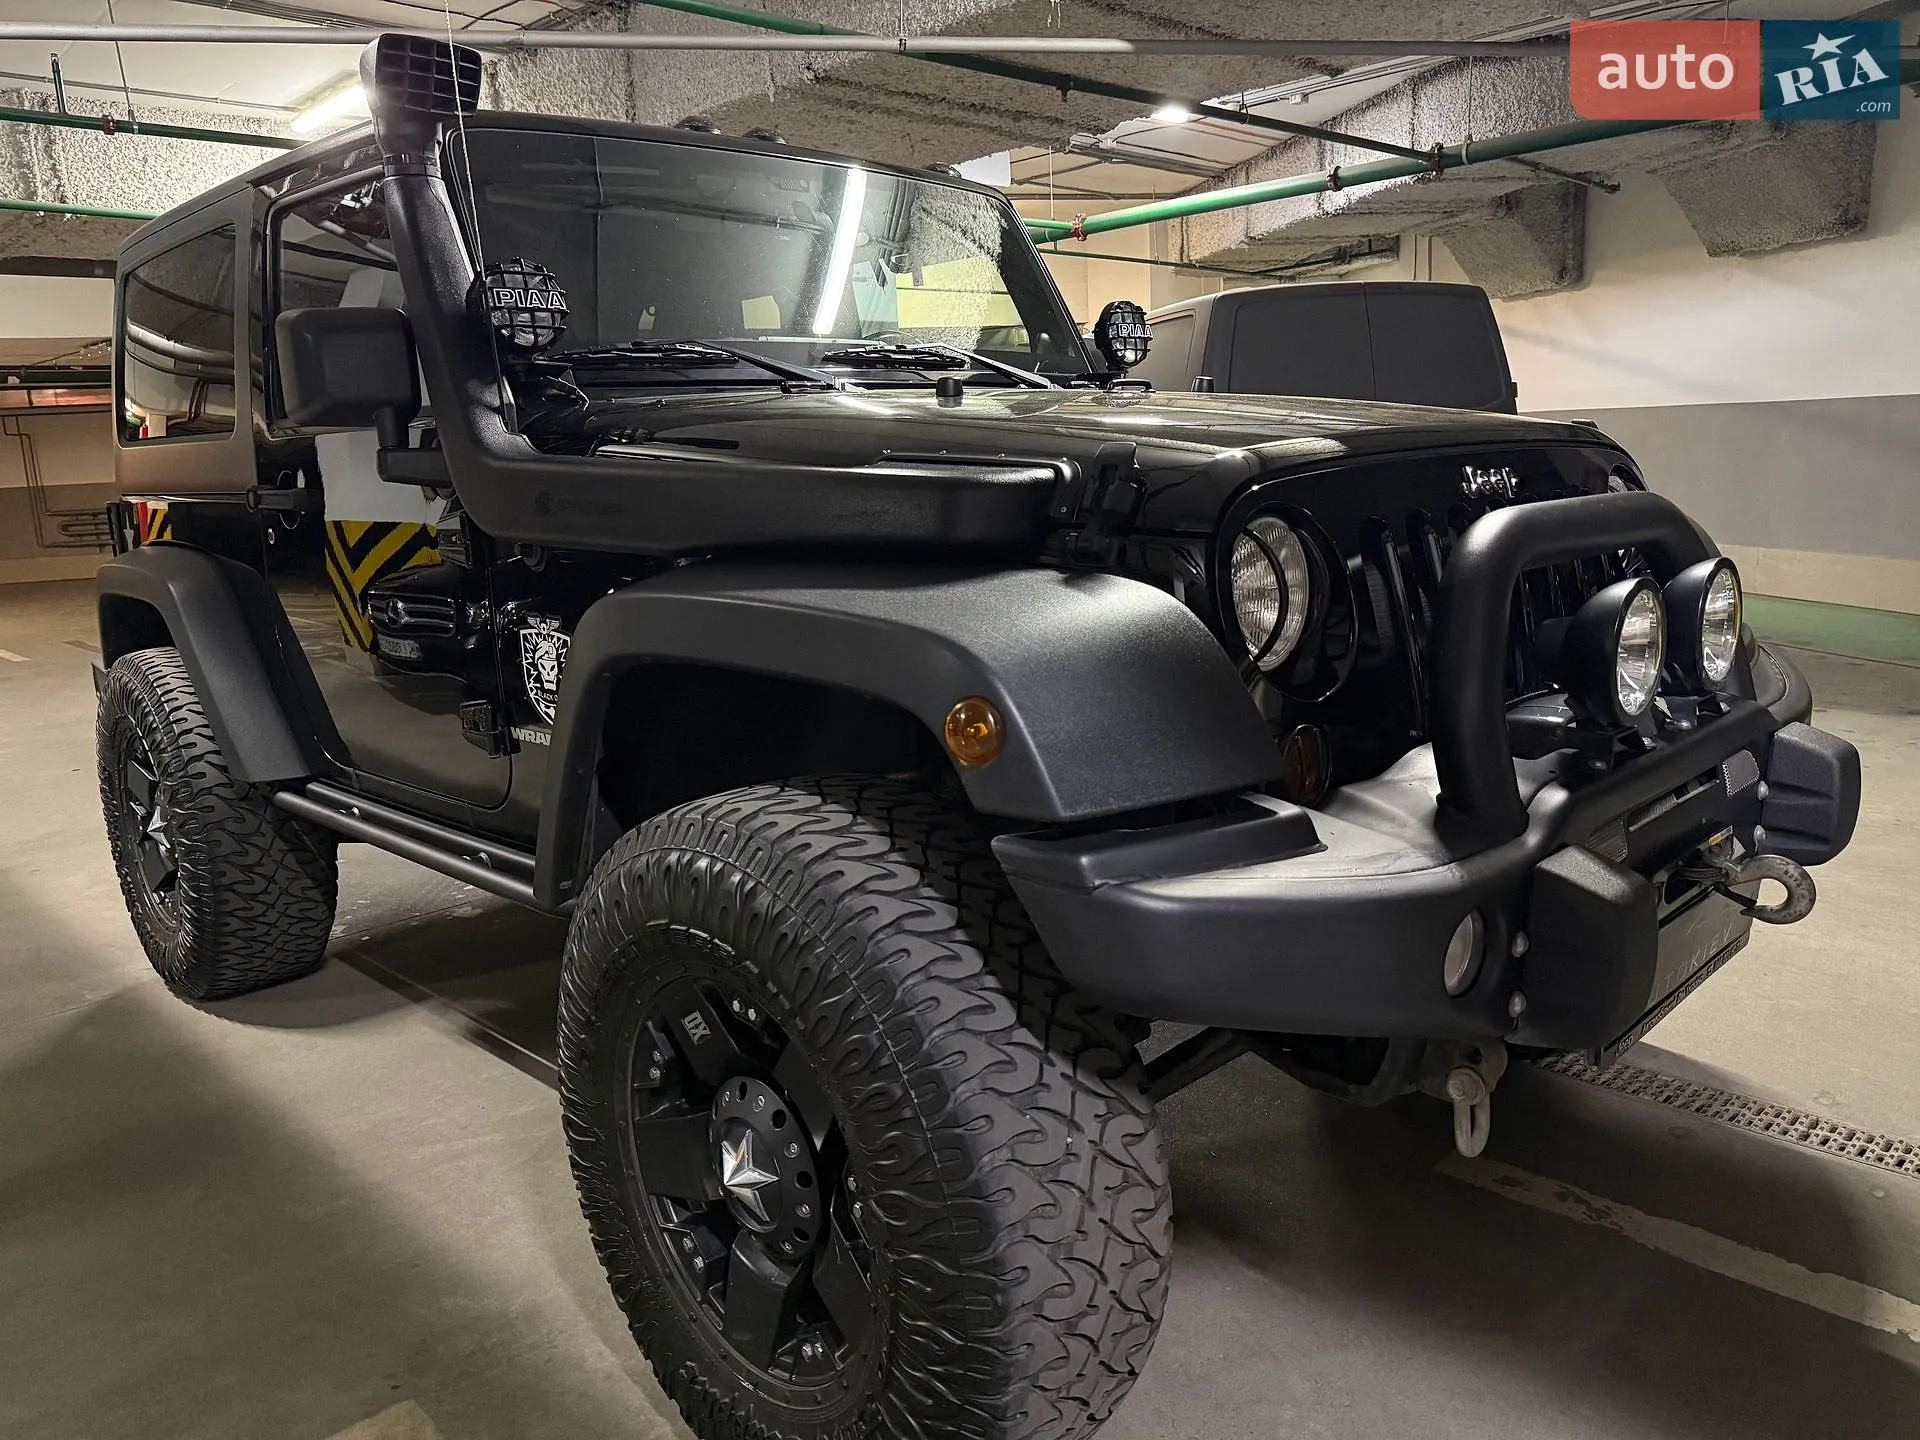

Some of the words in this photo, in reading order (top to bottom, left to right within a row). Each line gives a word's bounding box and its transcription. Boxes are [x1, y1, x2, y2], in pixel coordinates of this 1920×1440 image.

[493, 288, 567, 310] PIAA
[1118, 323, 1153, 338] PIAA
[1461, 465, 1519, 499] Jeep
